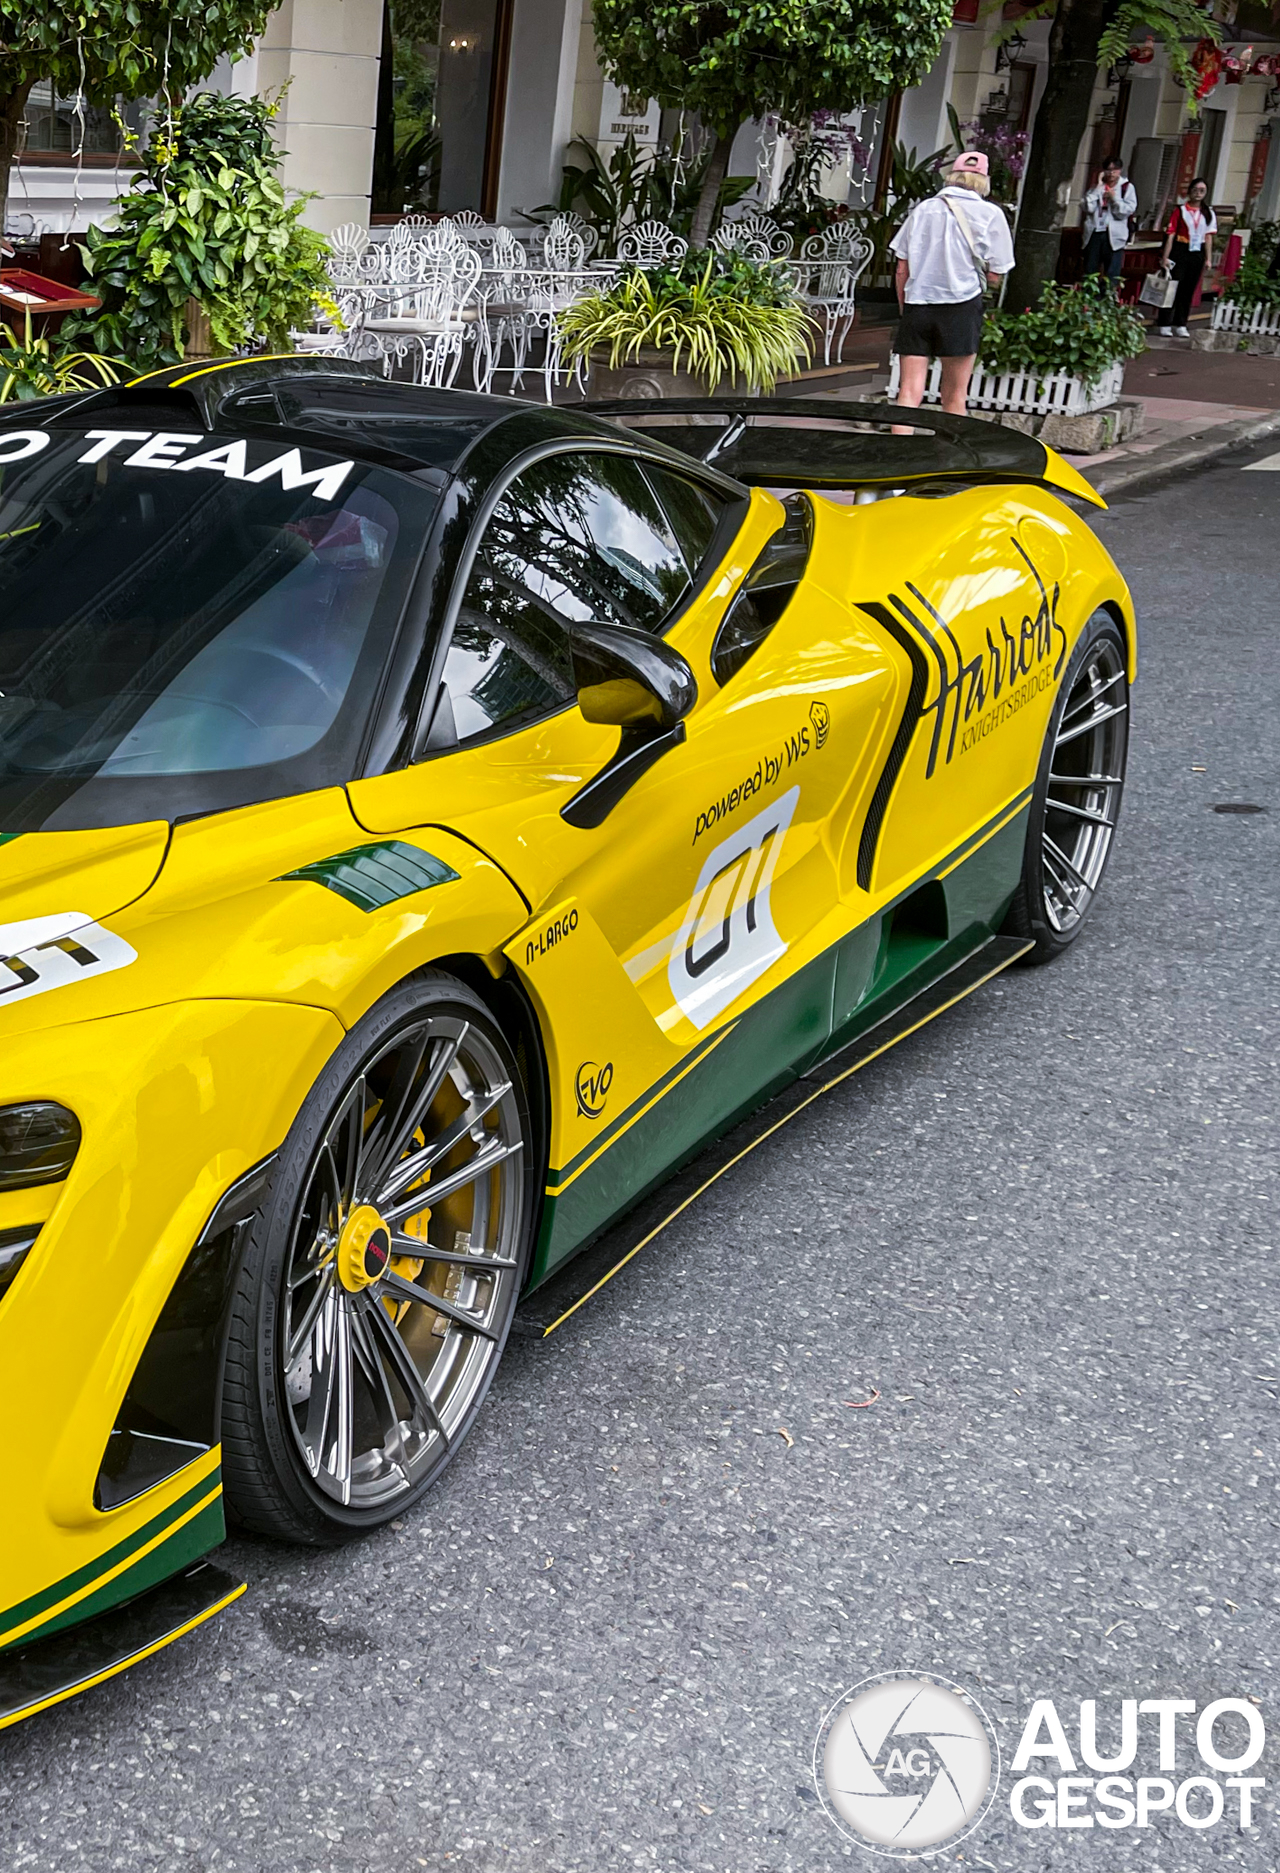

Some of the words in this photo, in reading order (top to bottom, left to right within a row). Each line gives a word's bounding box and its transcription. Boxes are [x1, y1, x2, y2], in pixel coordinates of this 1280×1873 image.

[76, 430, 355, 501] TEAM
[887, 536, 1067, 781] Harrods
[959, 663, 1053, 756] KNIGHTSBRIDGE
[692, 761, 762, 847] powered
[764, 752, 784, 786] by
[784, 727, 811, 768] WS
[685, 823, 780, 978] 01
